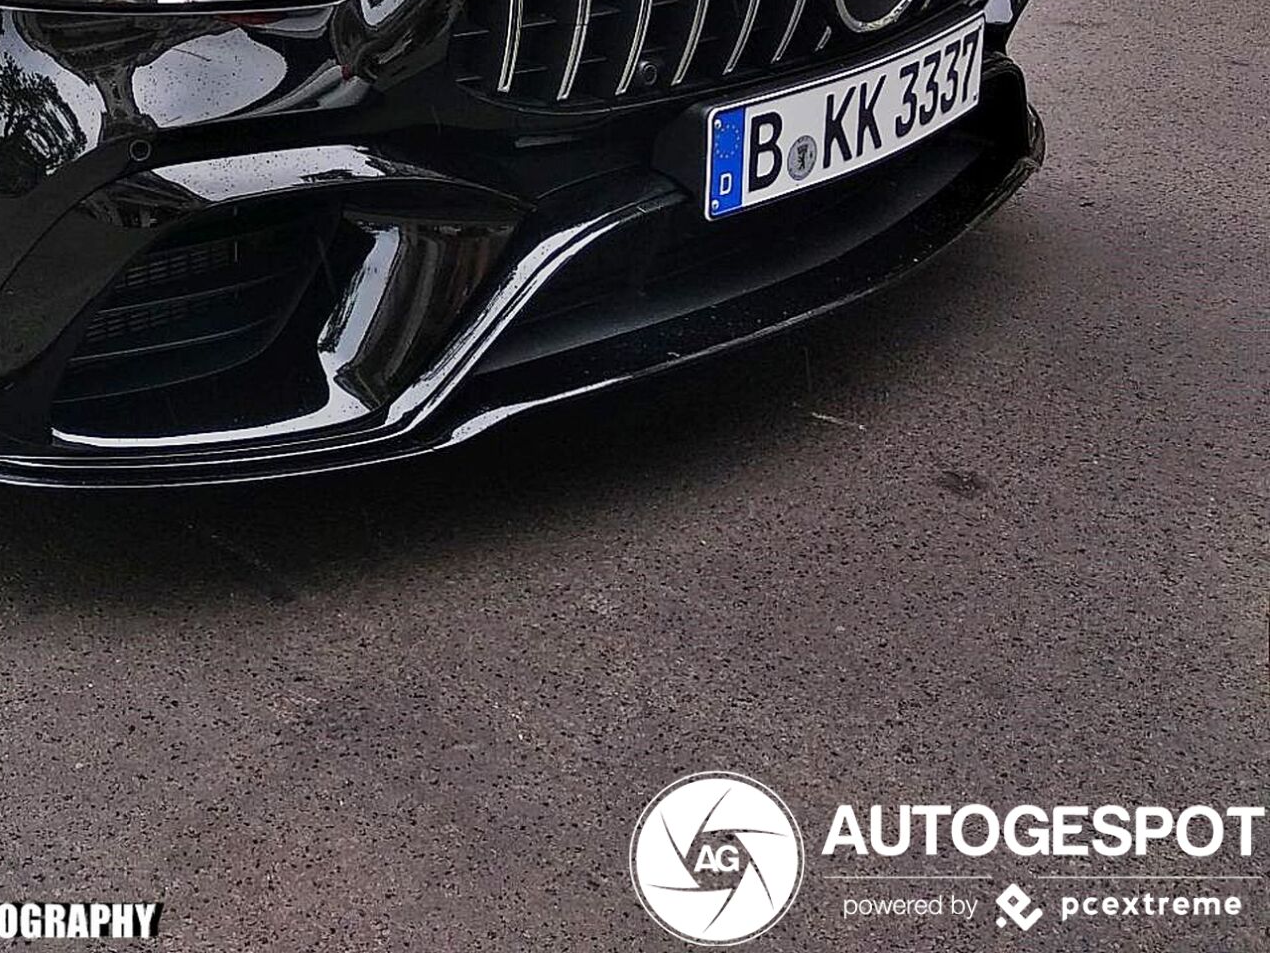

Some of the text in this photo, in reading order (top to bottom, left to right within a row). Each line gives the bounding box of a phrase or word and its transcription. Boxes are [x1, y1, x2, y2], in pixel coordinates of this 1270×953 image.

[748, 111, 784, 192] B
[822, 74, 887, 169] KK
[894, 30, 979, 139] 3337
[718, 171, 732, 196] D
